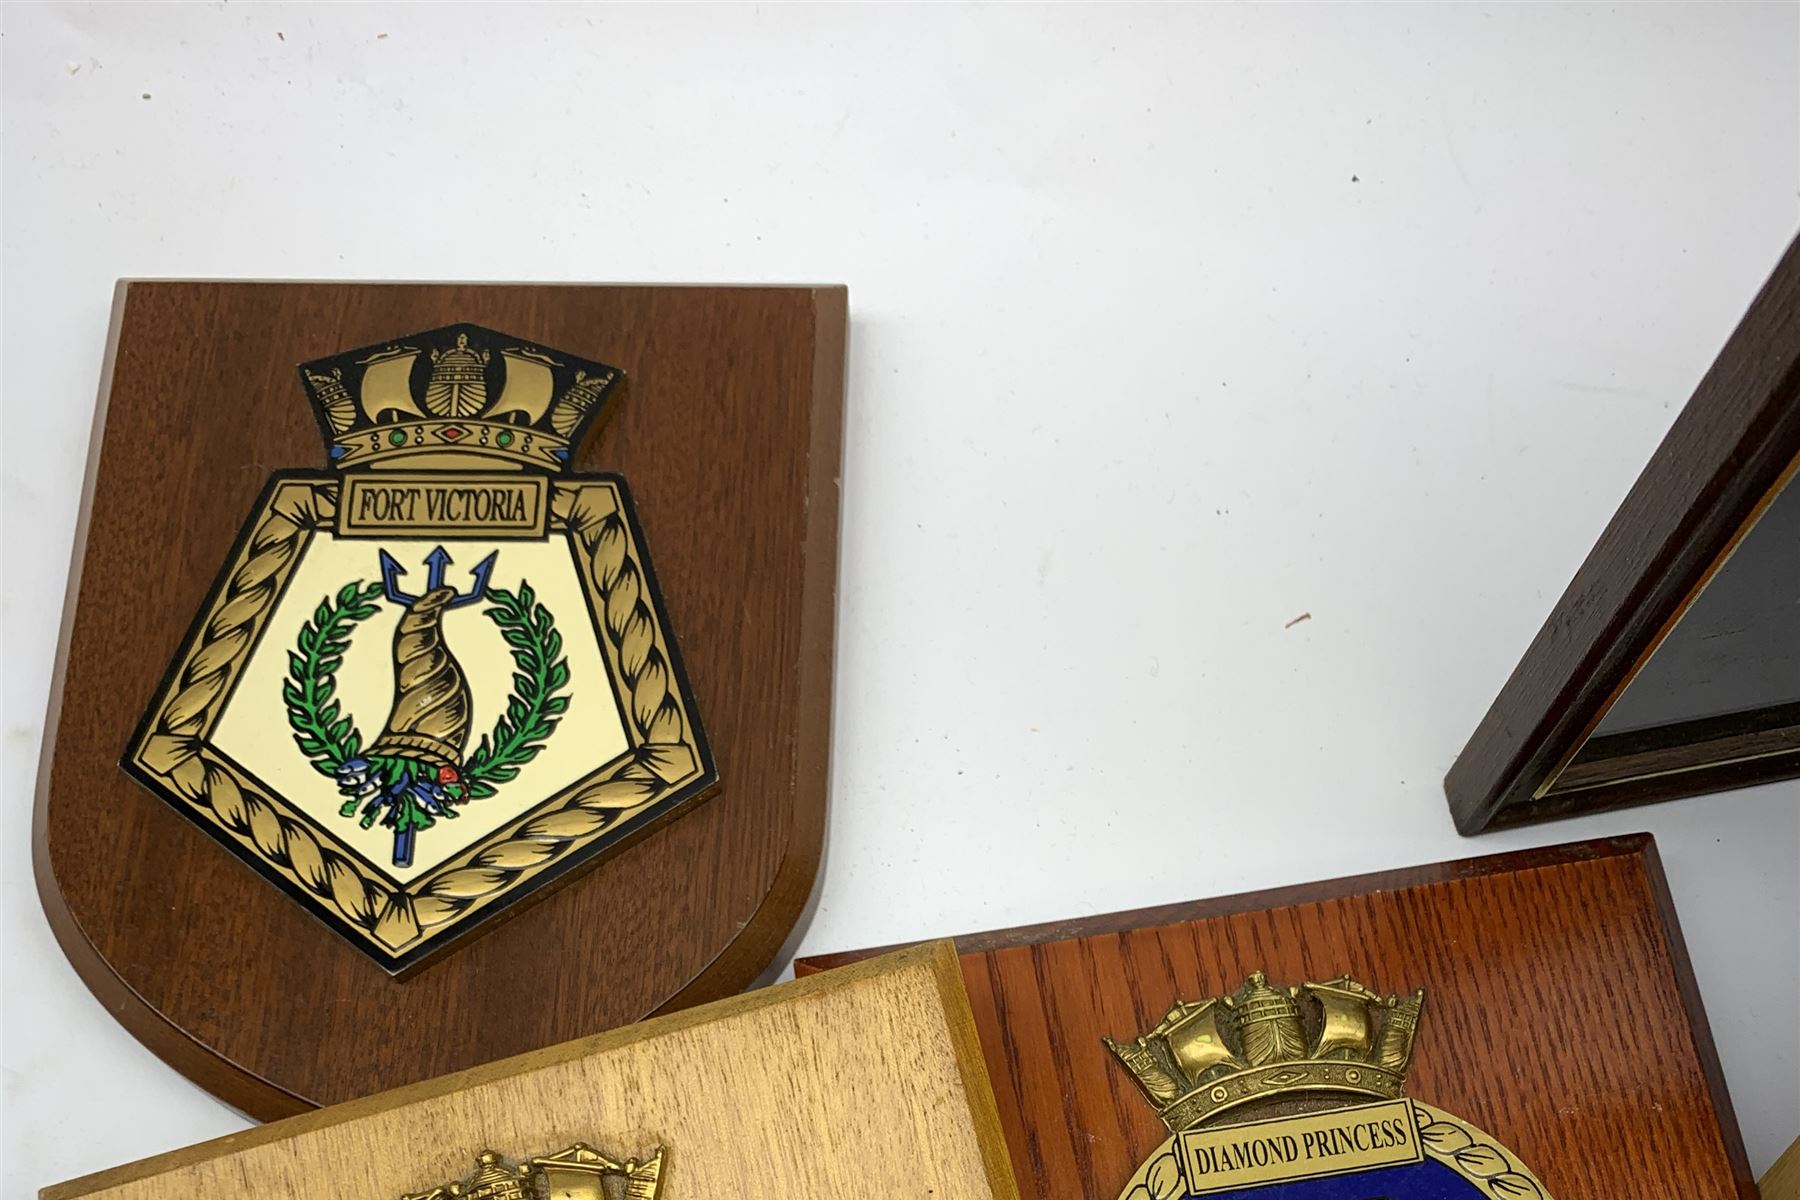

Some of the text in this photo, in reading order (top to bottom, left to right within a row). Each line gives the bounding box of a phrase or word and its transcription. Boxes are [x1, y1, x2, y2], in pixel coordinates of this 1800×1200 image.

[358, 488, 527, 522] FORT VICTORIA
[1194, 1118, 1407, 1175] DIAMOND PRINCESS
